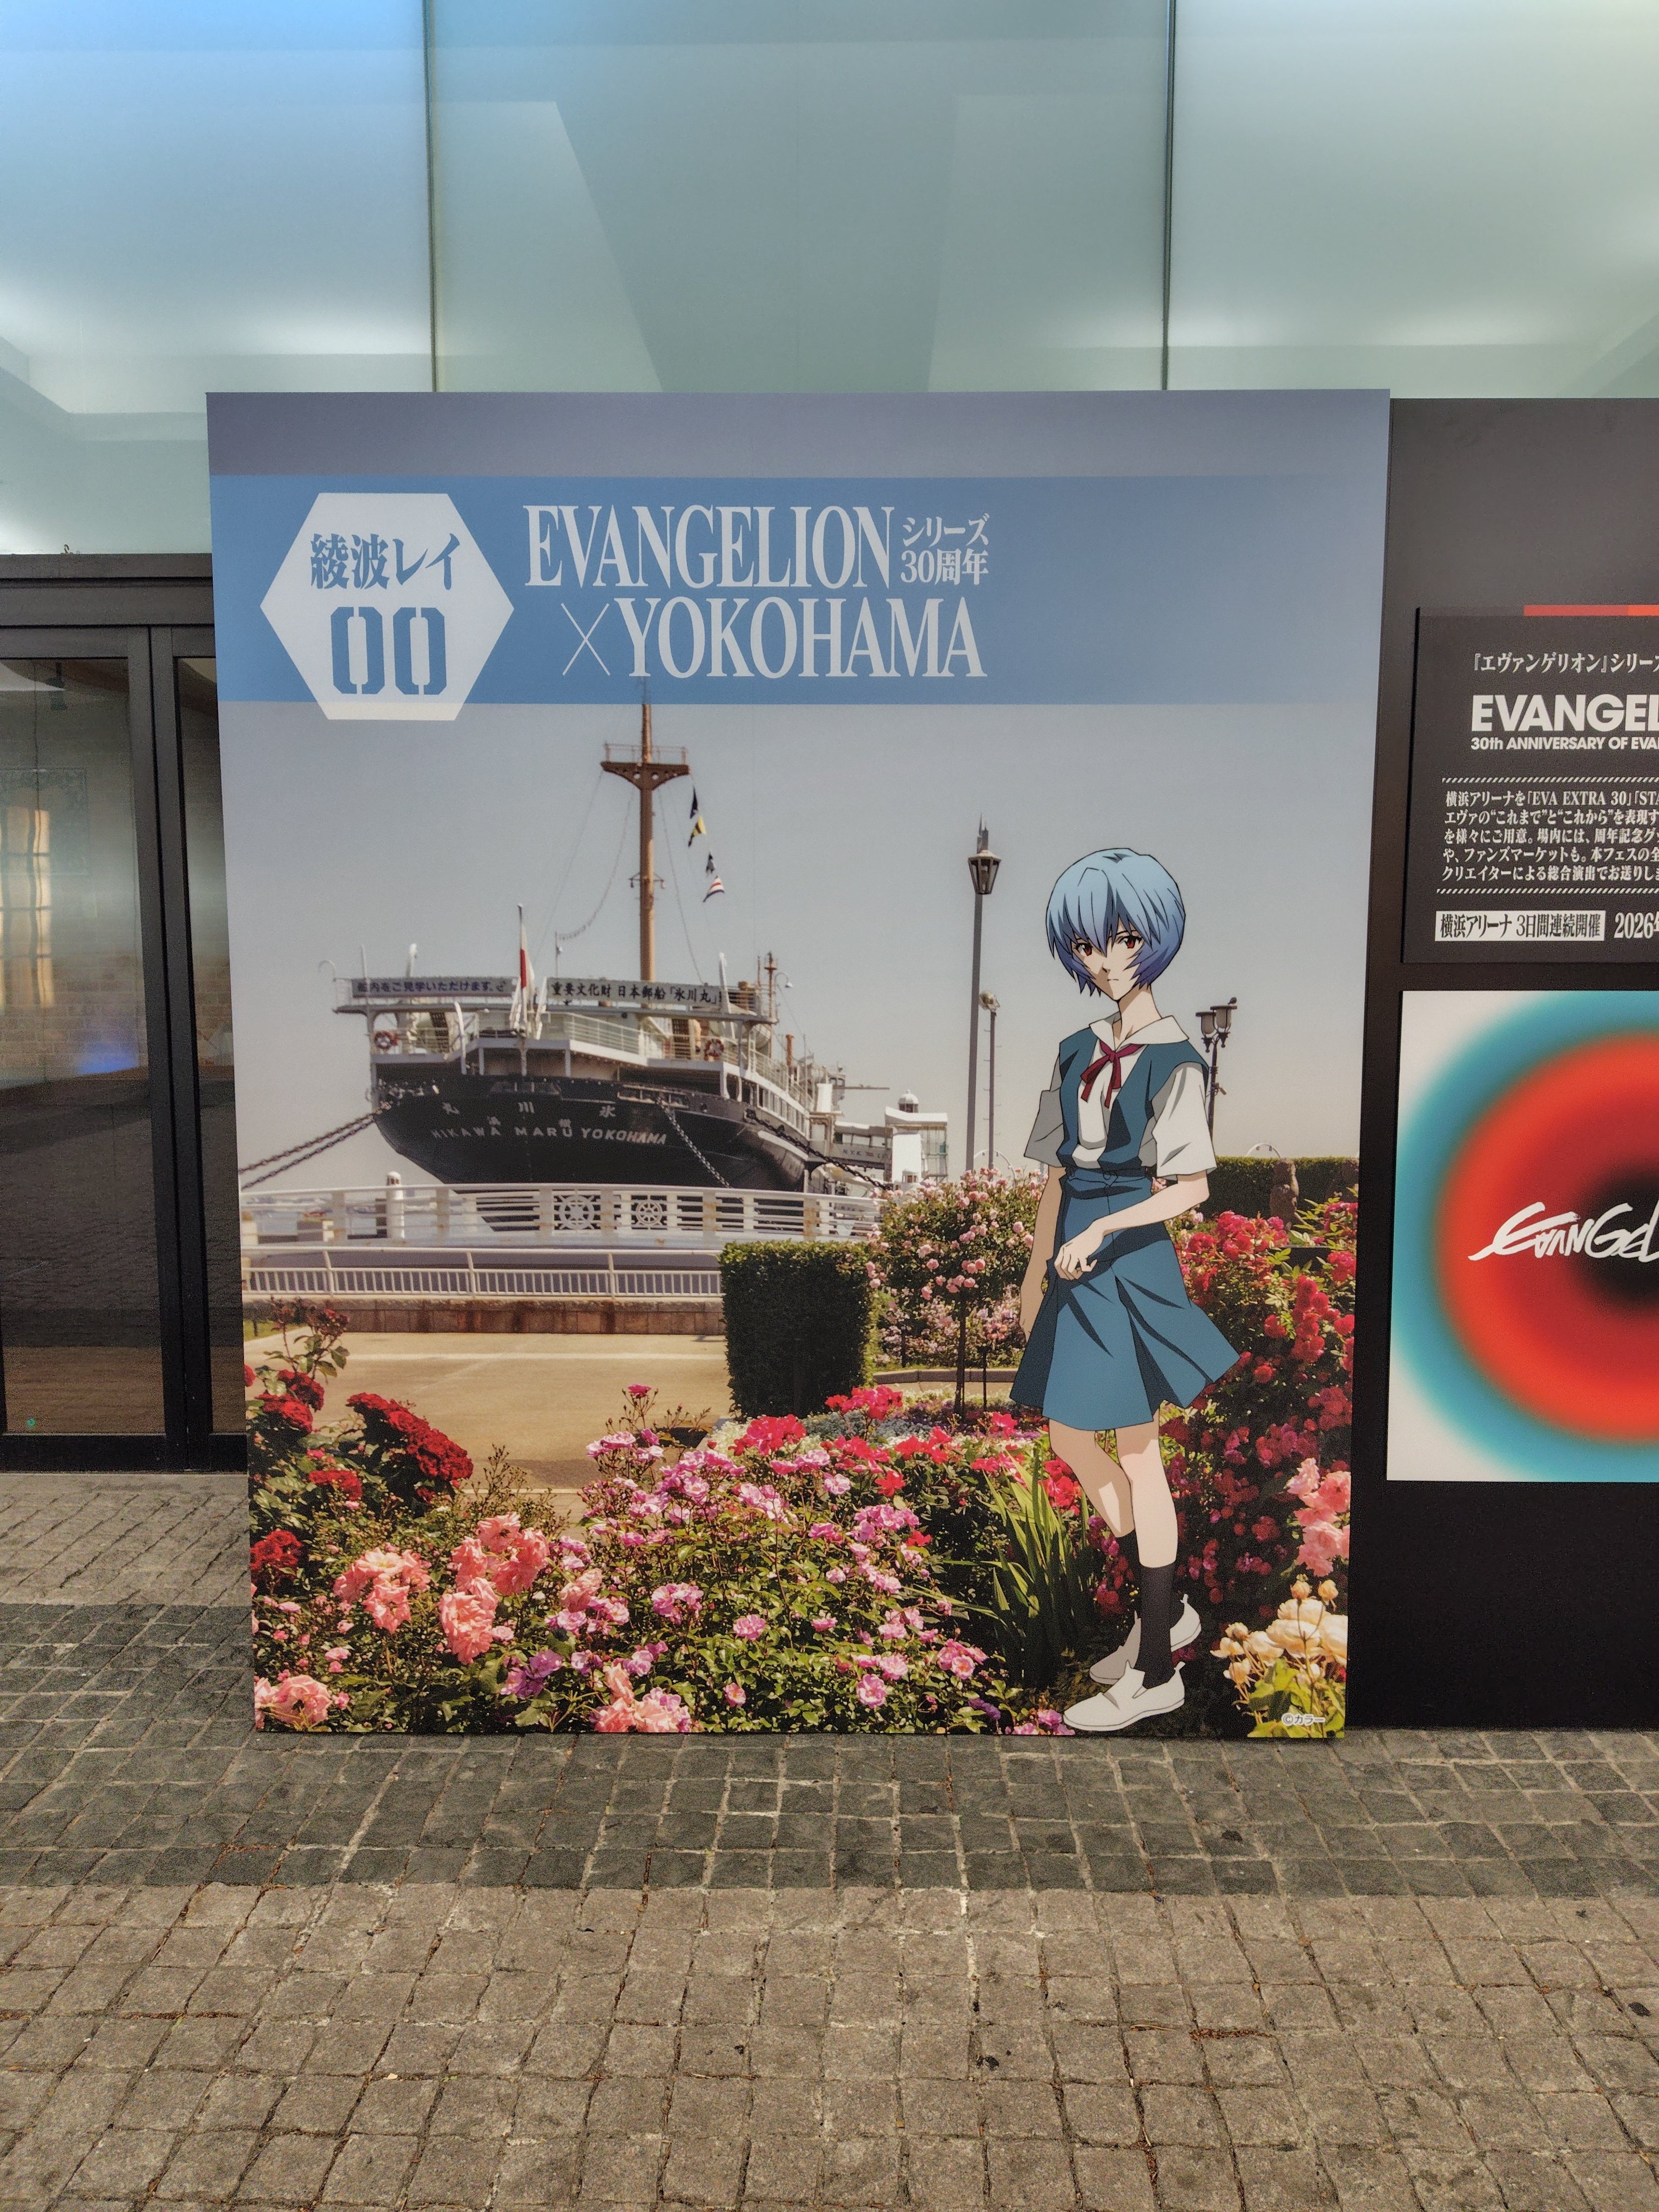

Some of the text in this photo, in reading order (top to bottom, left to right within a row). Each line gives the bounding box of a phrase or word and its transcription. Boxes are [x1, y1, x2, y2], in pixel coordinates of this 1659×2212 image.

[902, 513, 990, 547] シリーズ
[523, 504, 895, 589] EVANGELION
[311, 532, 460, 590] 綾波レイ
[900, 548, 989, 585] 30周年
[331, 606, 447, 695] 00
[1471, 737, 1659, 750] 30th ANNIVERSARY OF EVA
[1562, 791, 1606, 806] EXTRA
[1444, 828, 1659, 844] を様々にご用意。場内には、周年記念グ
[1440, 913, 1601, 938] 横浜アリーナ 3日間連続開催
[551, 981, 612, 997] 重要文化財
[515, 1126, 573, 1138] MARU
[581, 1127, 667, 1145] YOKOHAMA
